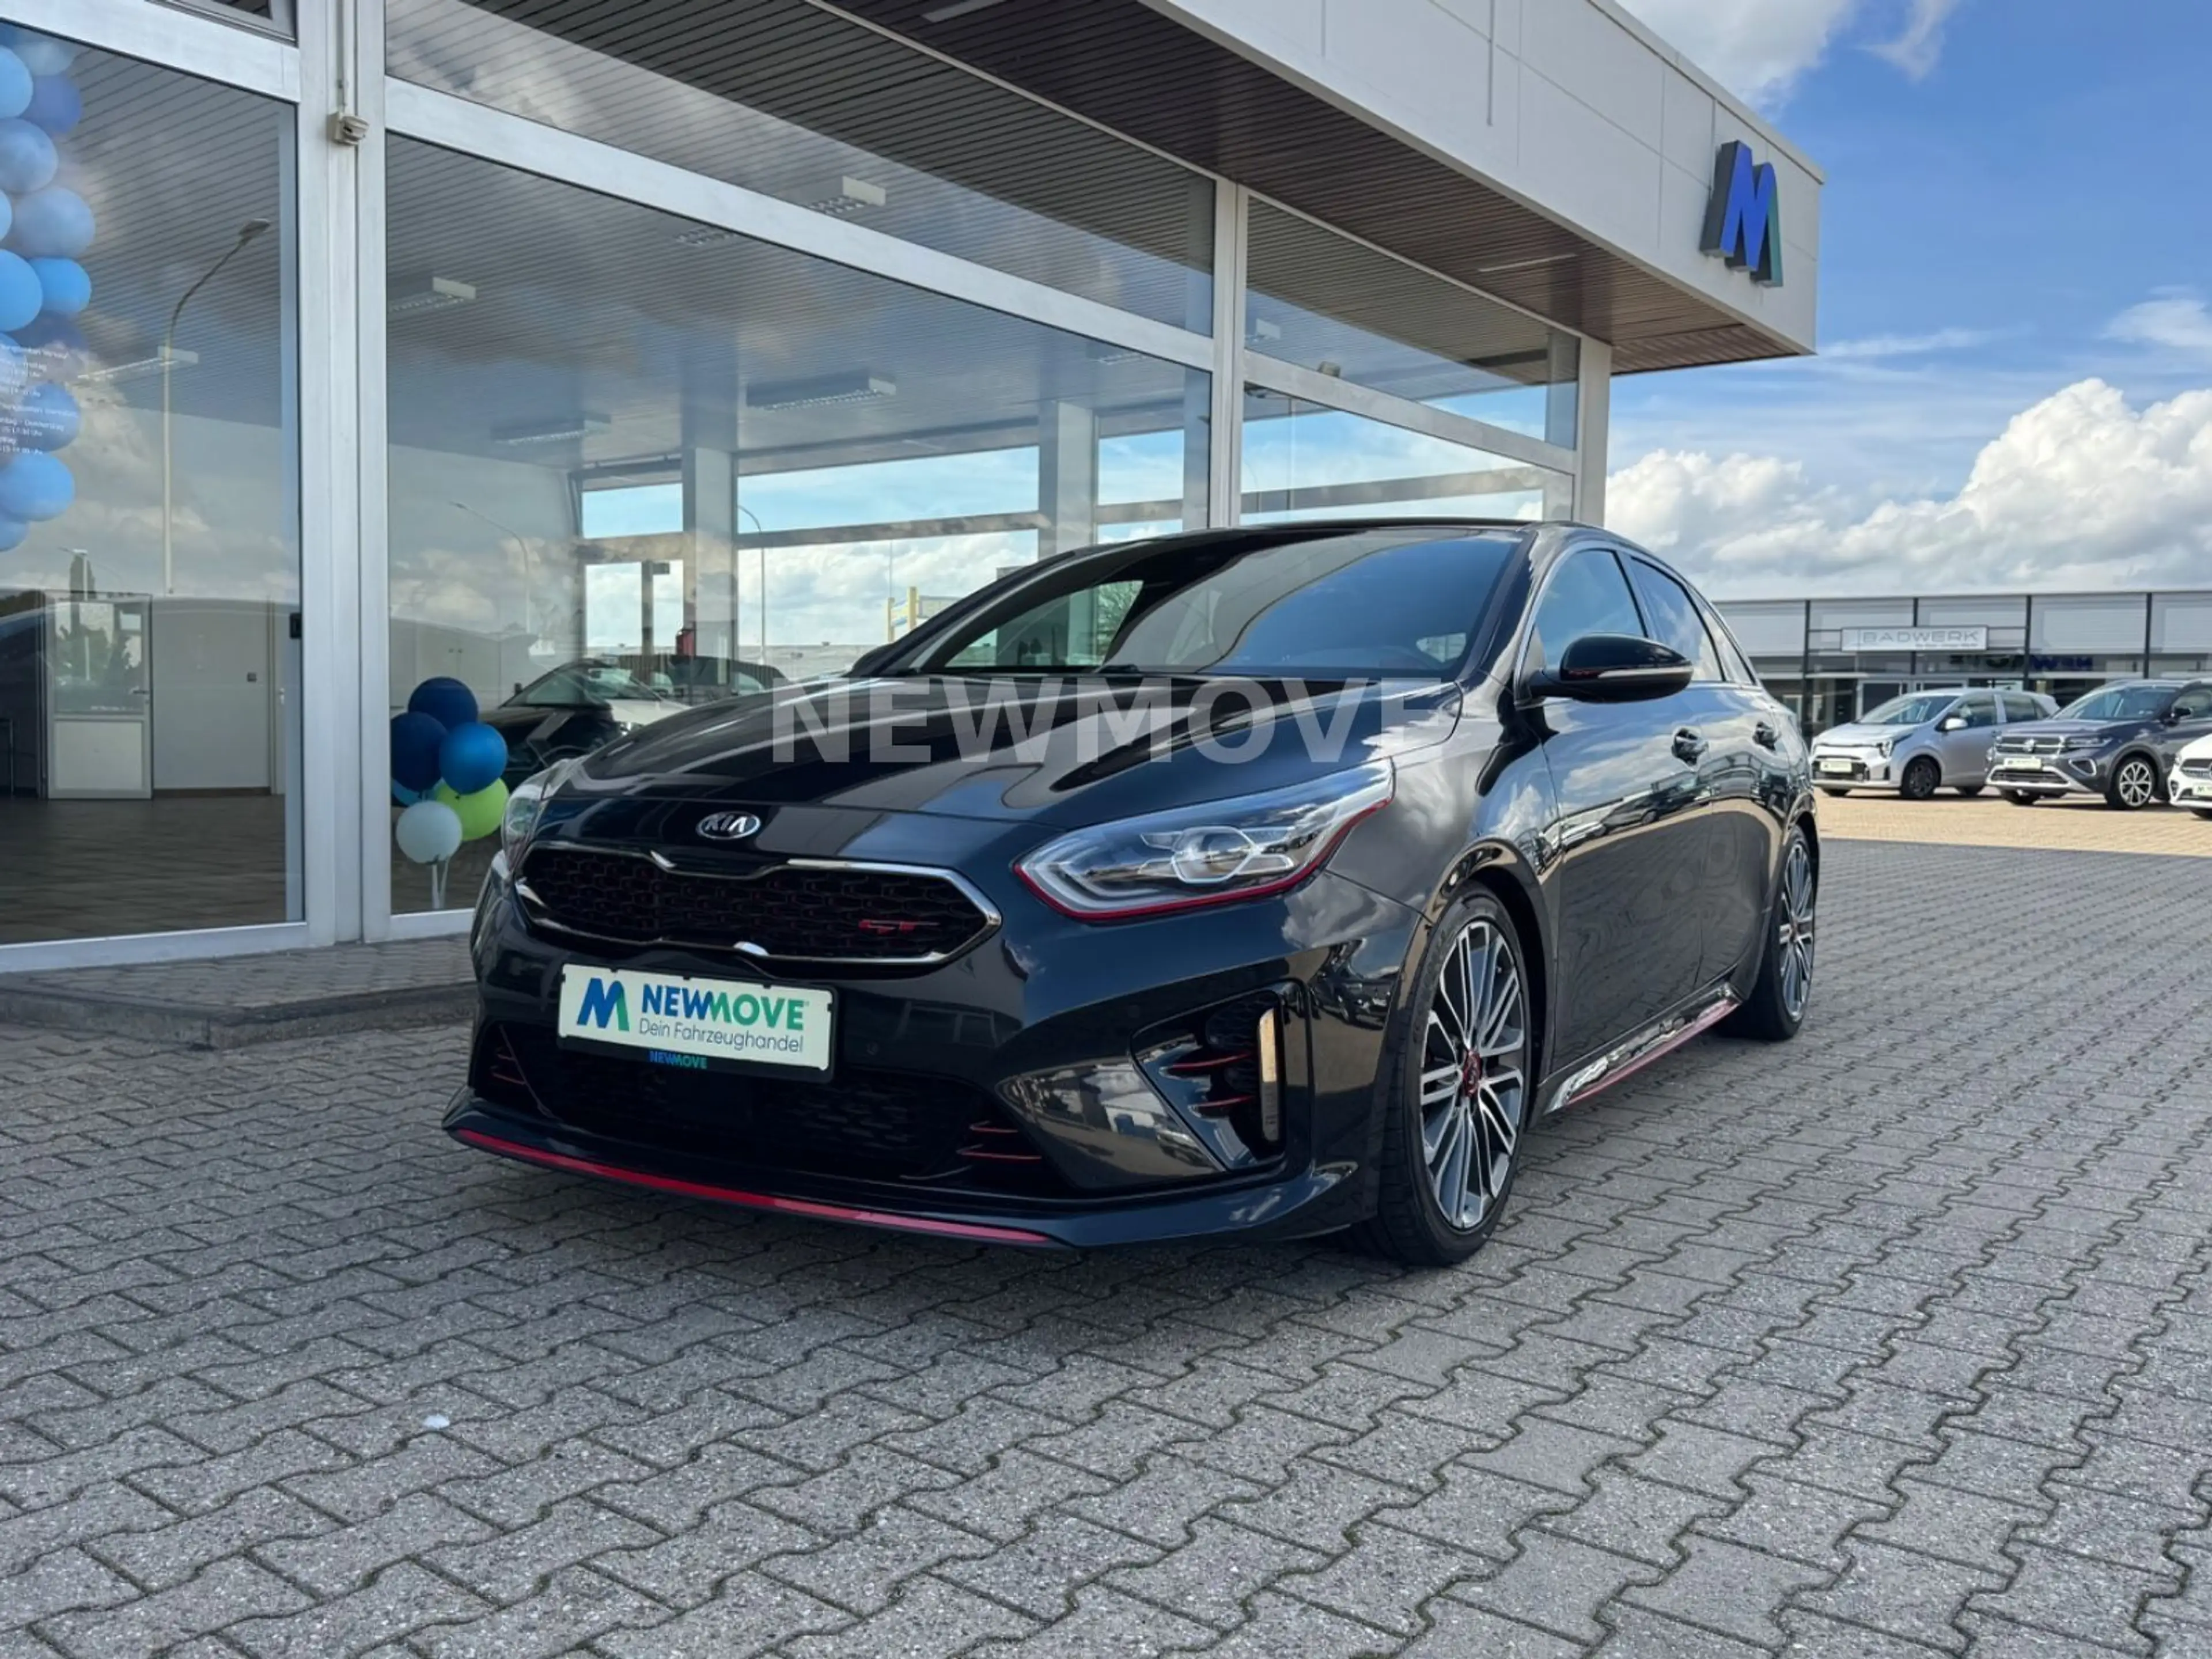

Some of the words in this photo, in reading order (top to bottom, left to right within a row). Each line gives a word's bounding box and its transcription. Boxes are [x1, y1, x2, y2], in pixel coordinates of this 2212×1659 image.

[1713, 140, 1783, 287] M
[704, 813, 748, 833] KIA
[641, 983, 809, 1031] NEWMOVE
[639, 1017, 671, 1037] Dein
[674, 1021, 804, 1053] Fahrzeughandel
[649, 1050, 708, 1070] NEWMOVE
